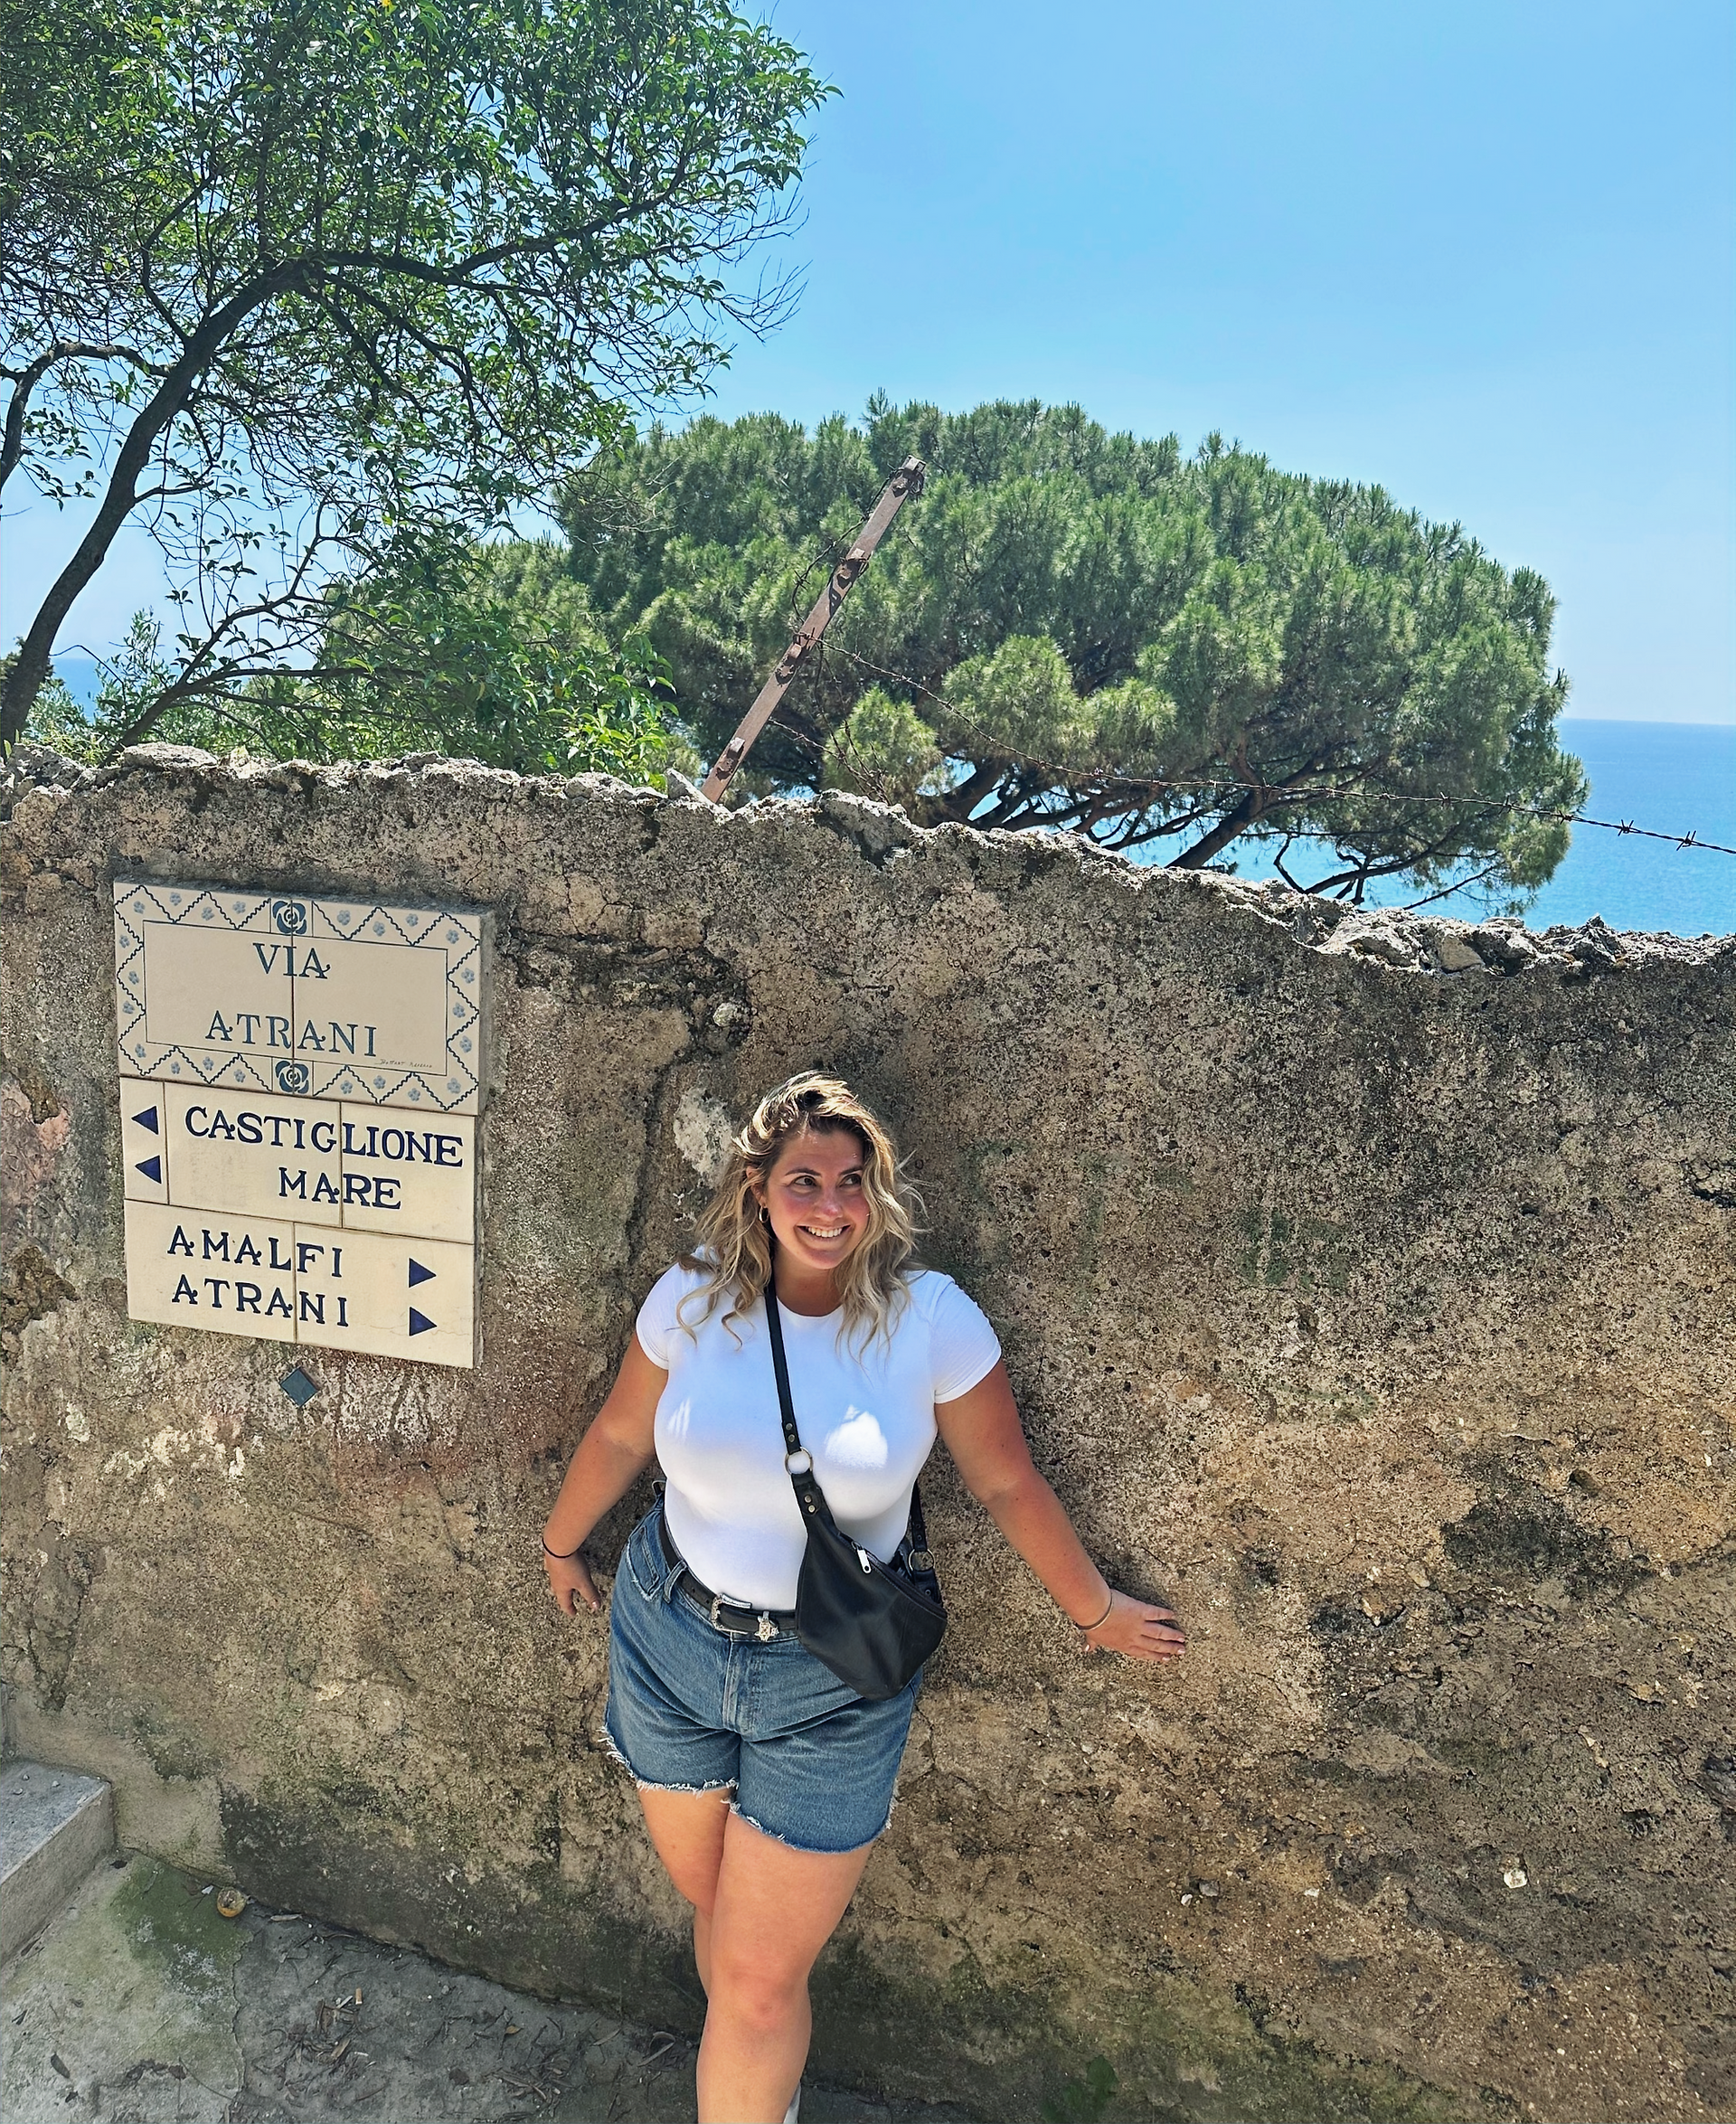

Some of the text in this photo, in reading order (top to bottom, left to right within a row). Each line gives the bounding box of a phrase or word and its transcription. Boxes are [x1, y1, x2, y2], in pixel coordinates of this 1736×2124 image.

[253, 942, 331, 979] VIA
[205, 1010, 377, 1057] ATRANI
[184, 1106, 463, 1167] CASTIGLIONE
[278, 1167, 401, 1209] MARE
[167, 1225, 343, 1278] AMALFI
[172, 1274, 348, 1326] ATRANI
